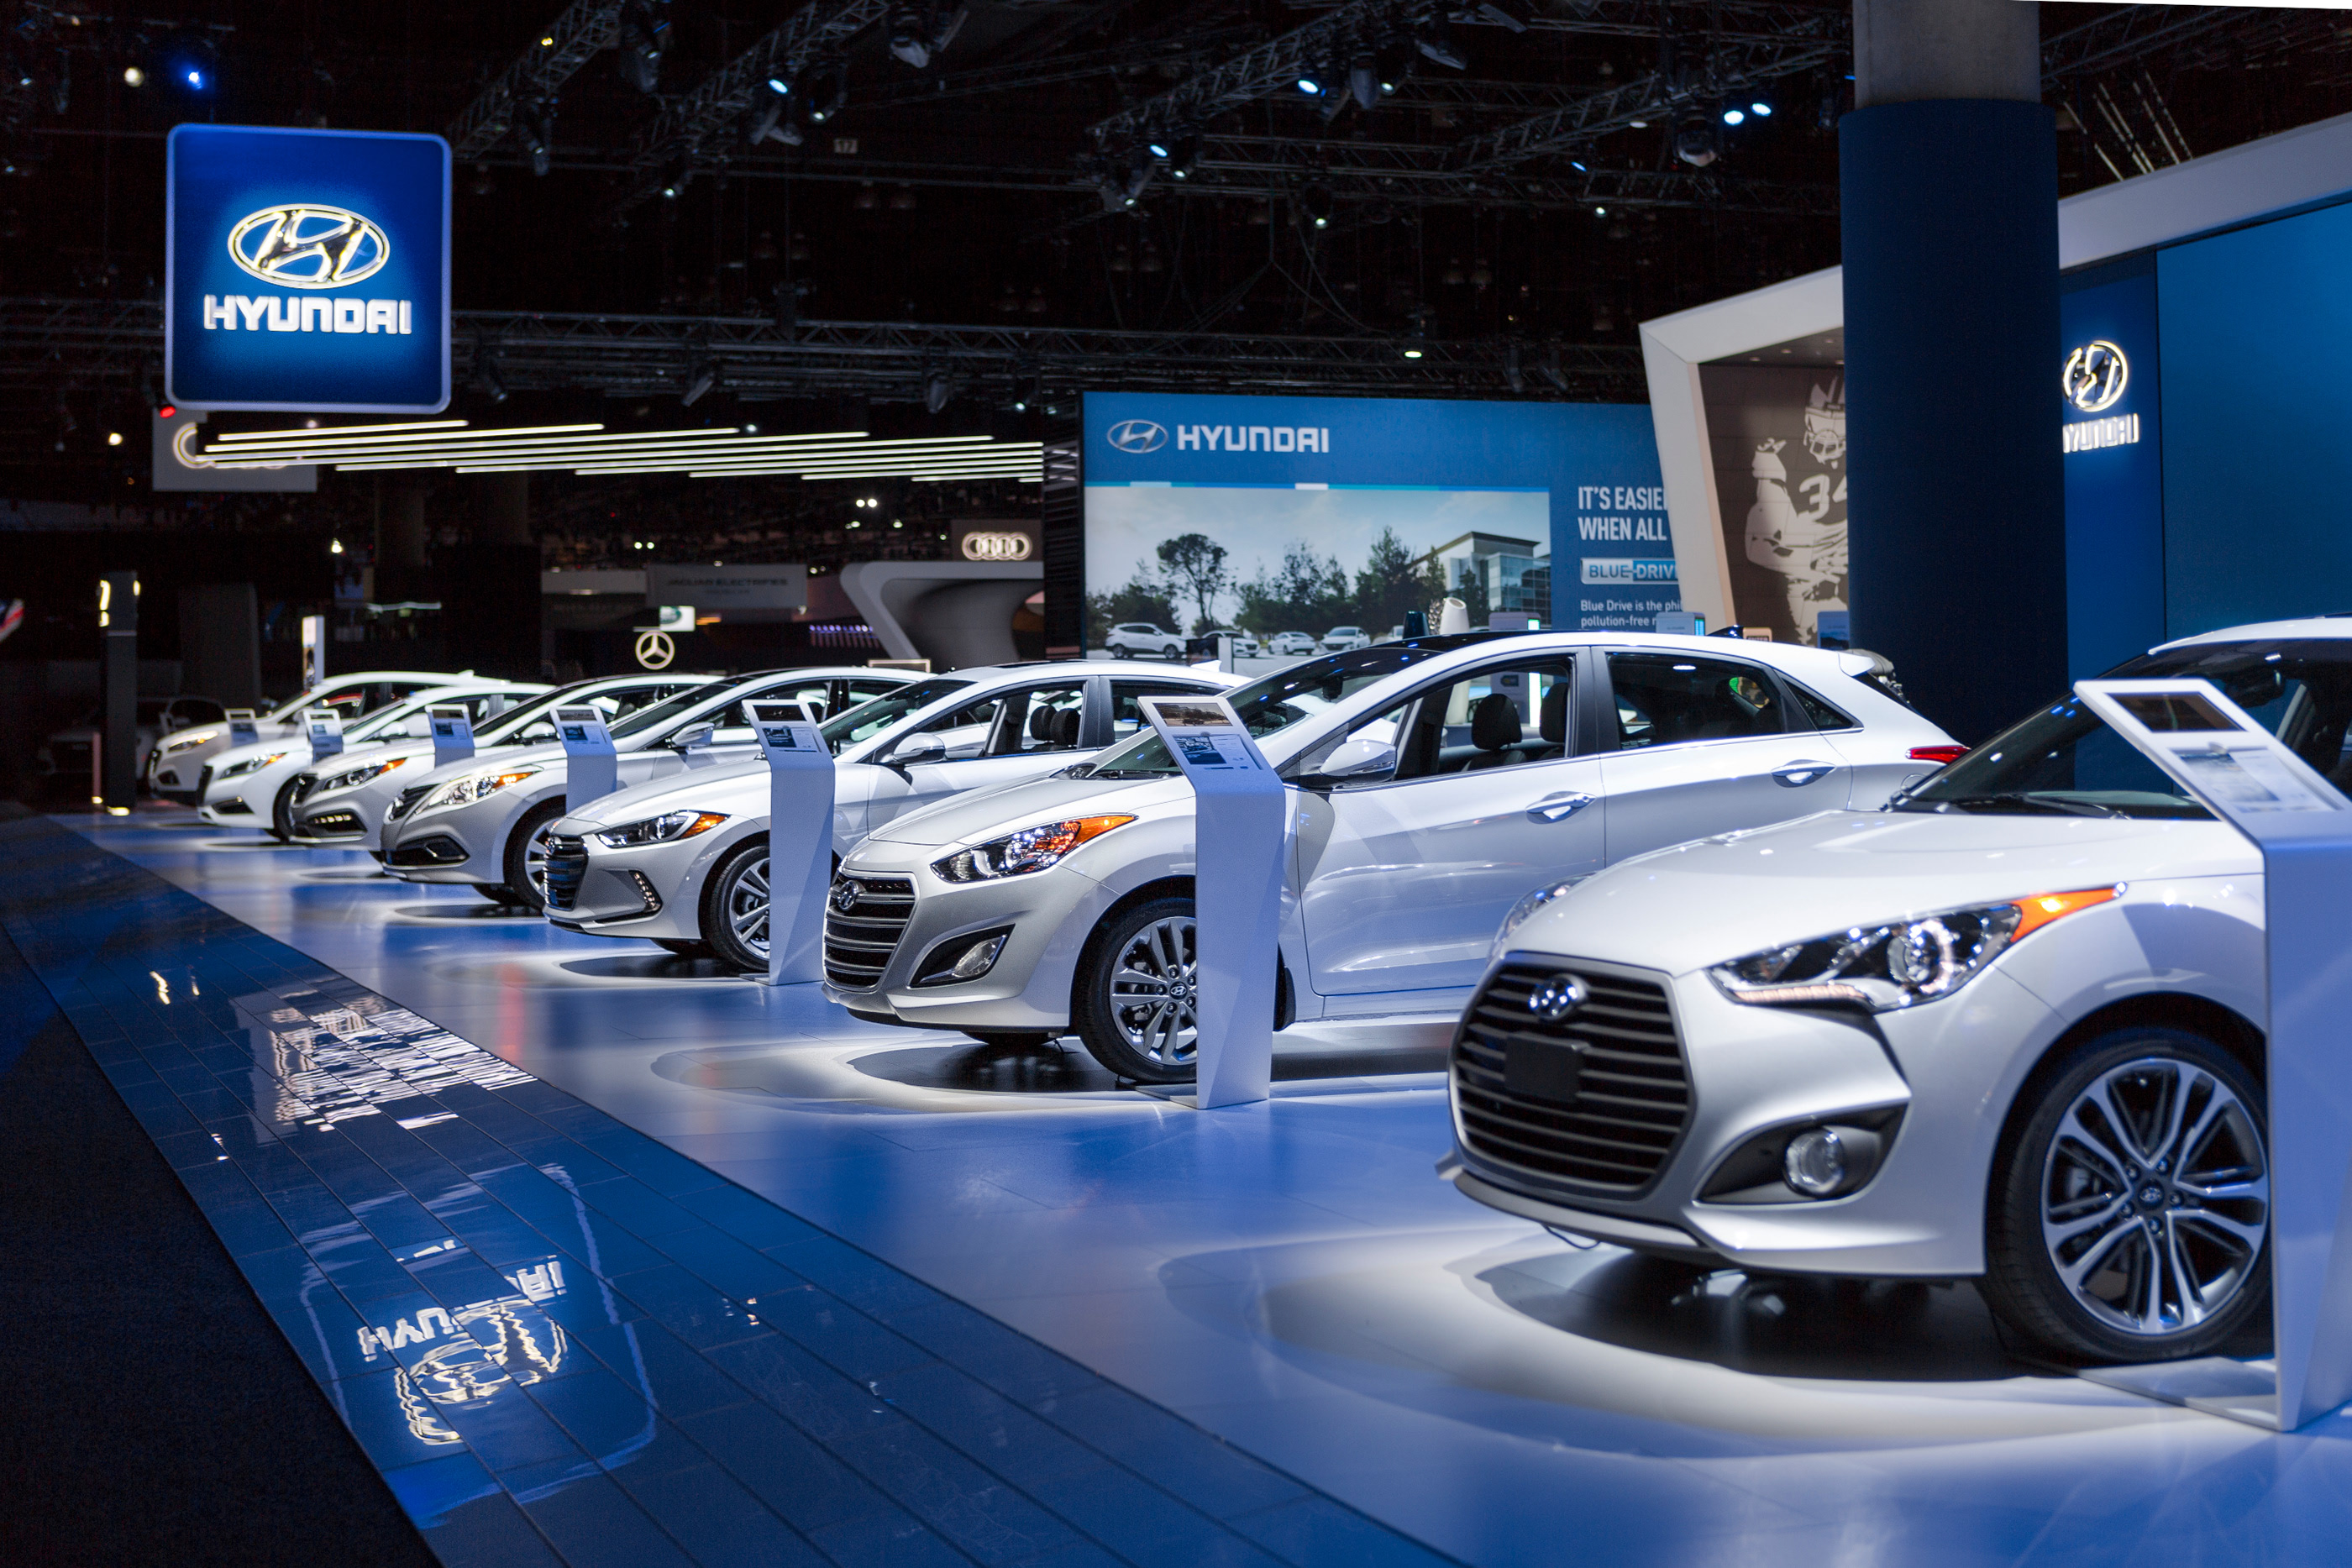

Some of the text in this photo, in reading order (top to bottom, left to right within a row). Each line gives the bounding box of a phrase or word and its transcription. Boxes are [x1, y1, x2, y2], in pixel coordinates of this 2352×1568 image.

[203, 294, 412, 334] HYUNDAI
[1177, 424, 1330, 454] HYUNDAI
[1578, 486, 1668, 511] IT'S EASIE
[1578, 517, 1667, 541] WHEN ALL
[1580, 599, 1681, 613] Blue Drive is the phi
[1580, 614, 1650, 629] pollution-free
